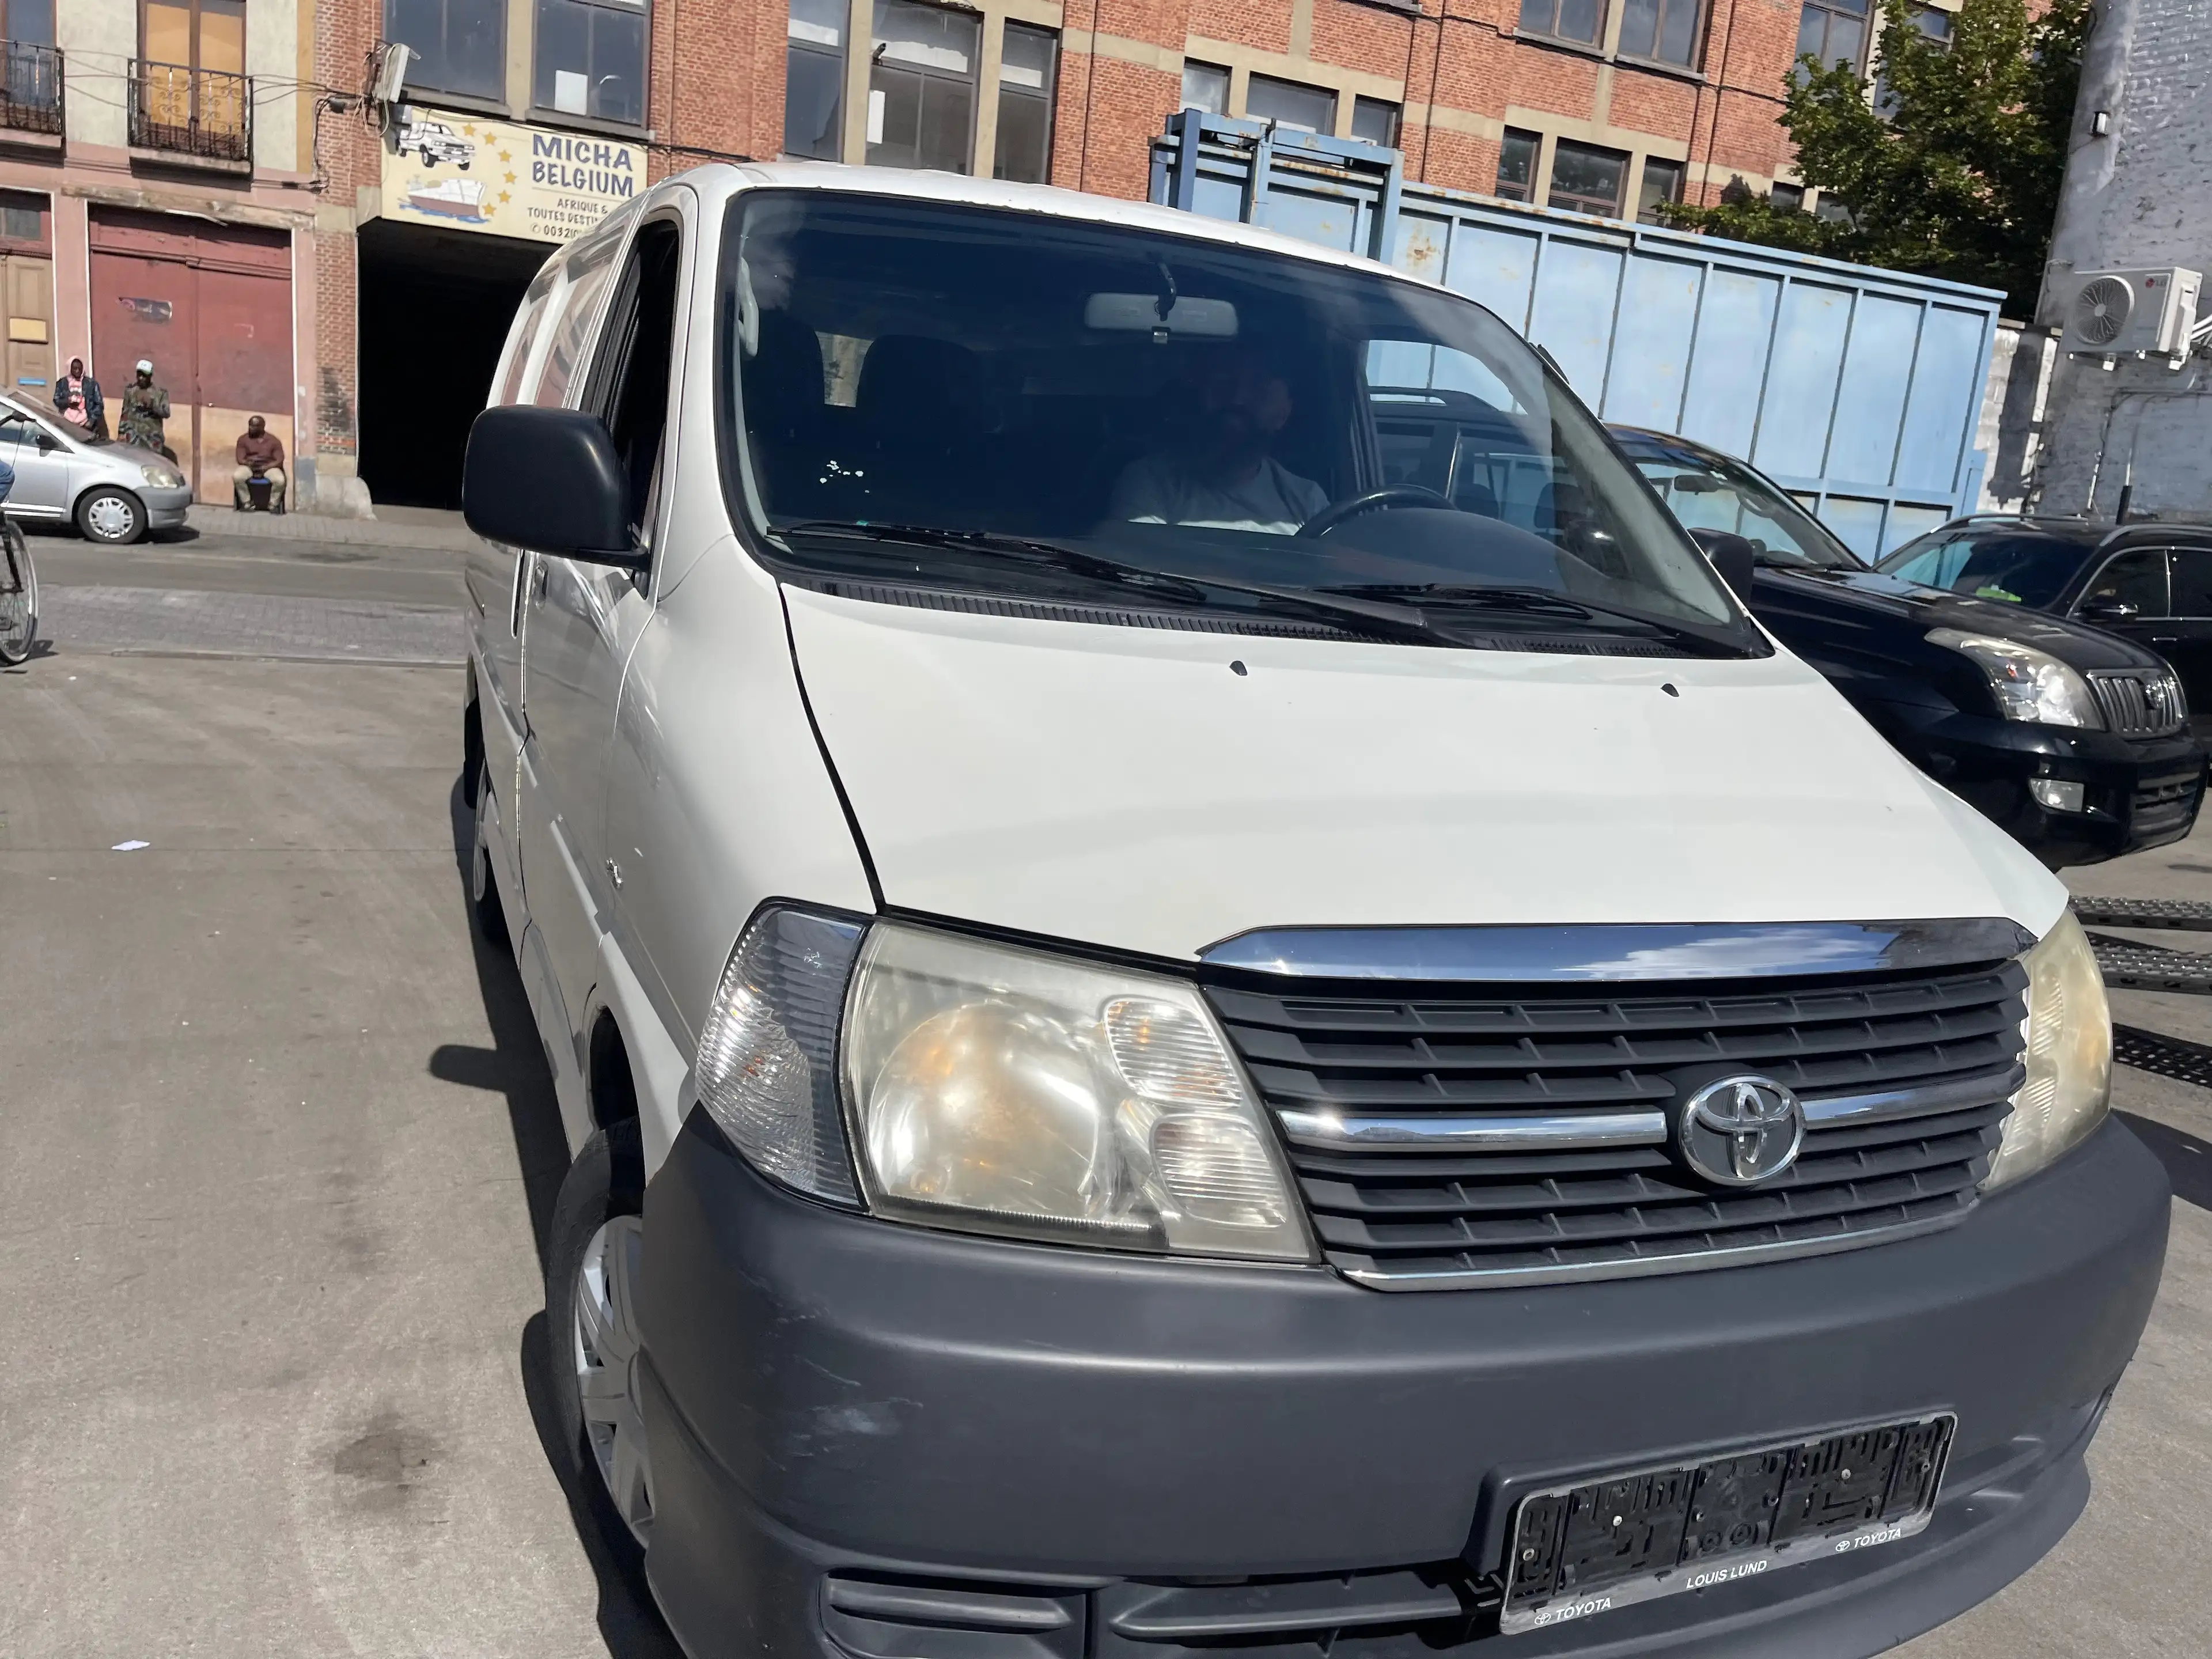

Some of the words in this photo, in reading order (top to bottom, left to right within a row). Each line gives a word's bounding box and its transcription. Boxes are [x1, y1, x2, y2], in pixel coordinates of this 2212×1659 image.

[533, 133, 632, 172] MICHA
[532, 161, 632, 197] BELGIUM
[528, 207, 565, 222] TOUTES
[557, 198, 599, 214] AFRIQUE
[1854, 1528, 1901, 1548] TOYOTA
[1685, 1569, 1728, 1589] LOUIS
[1730, 1560, 1768, 1579] LUND
[1556, 1597, 1611, 1620] TOYOTA
